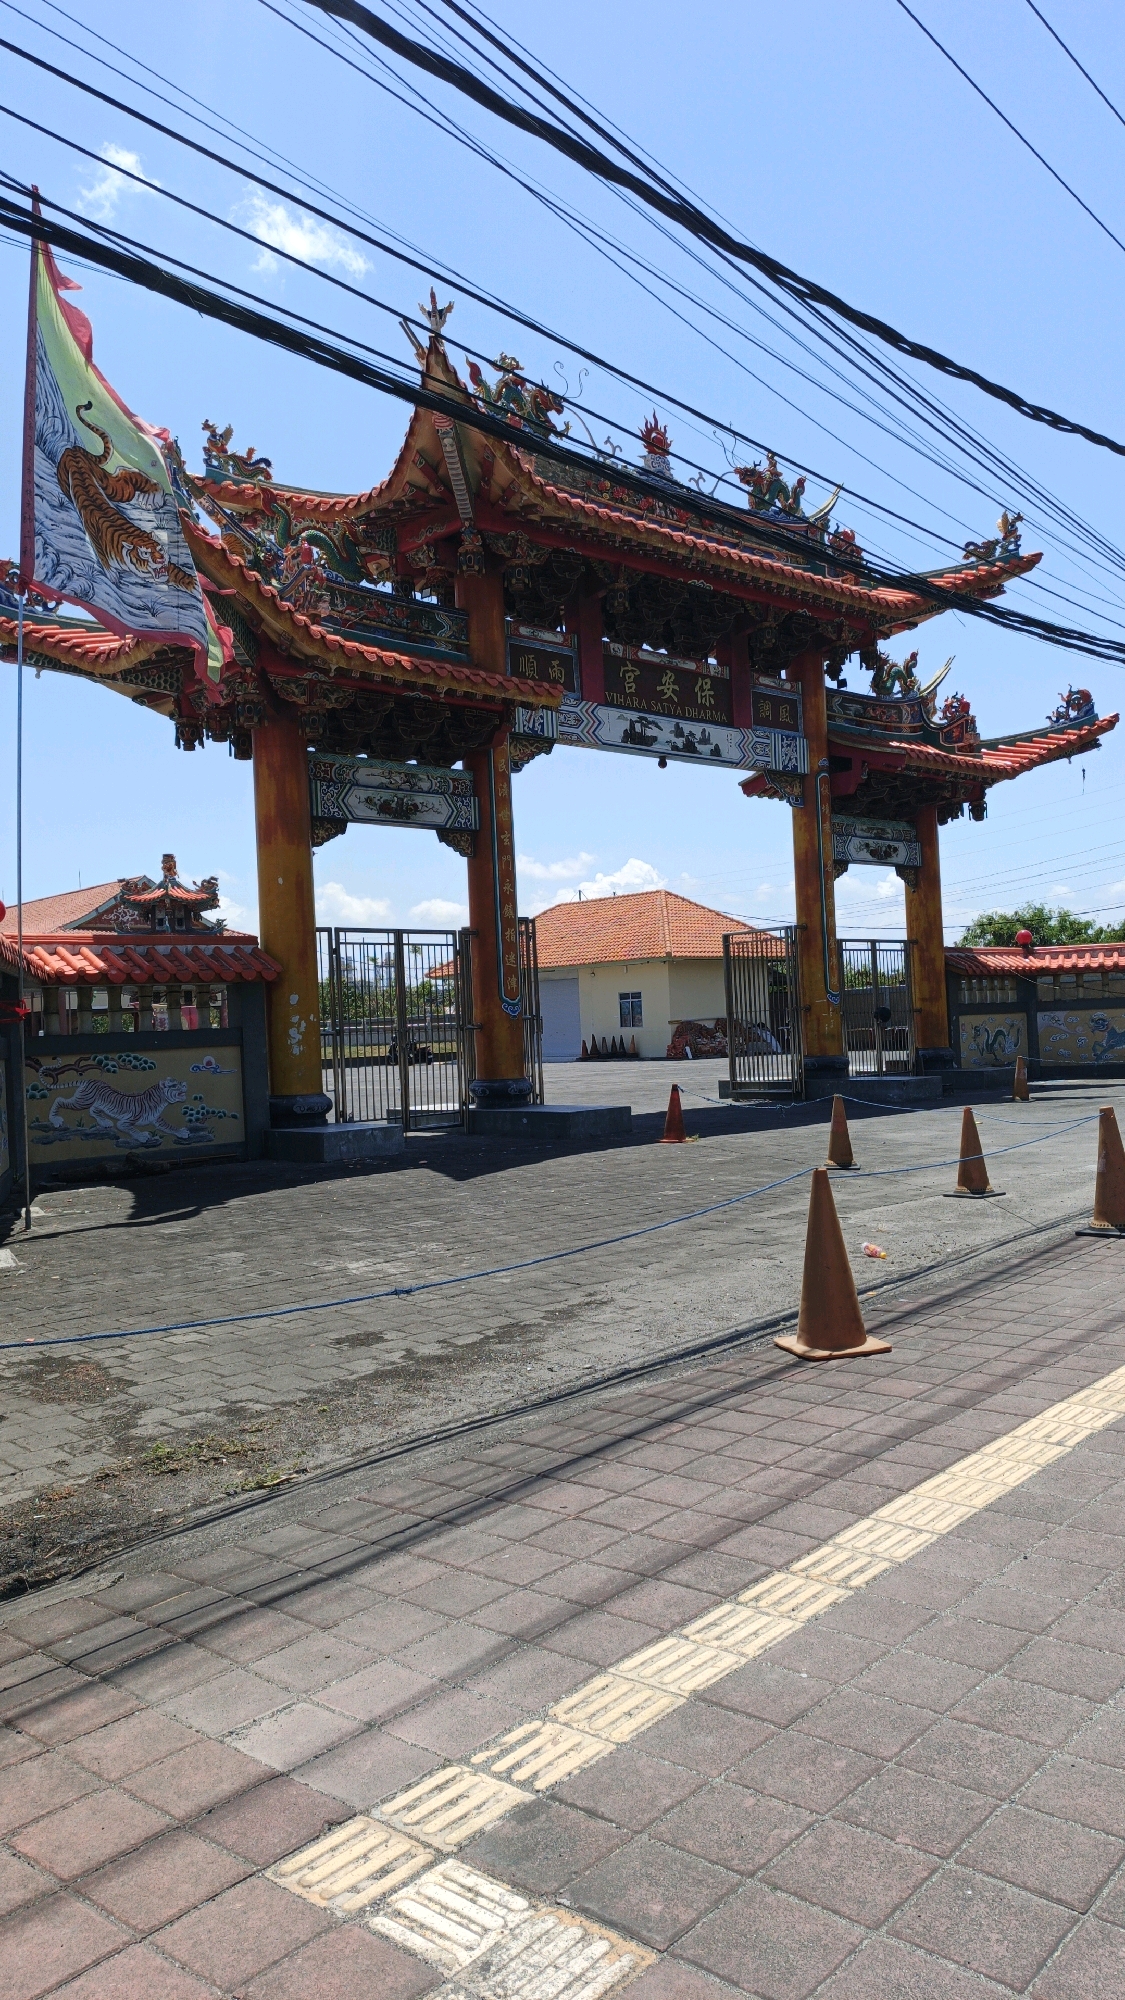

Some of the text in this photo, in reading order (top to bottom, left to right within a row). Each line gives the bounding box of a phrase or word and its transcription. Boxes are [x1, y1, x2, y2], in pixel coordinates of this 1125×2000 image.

[605, 692, 728, 723] VIHARA SATYA DHARMA
